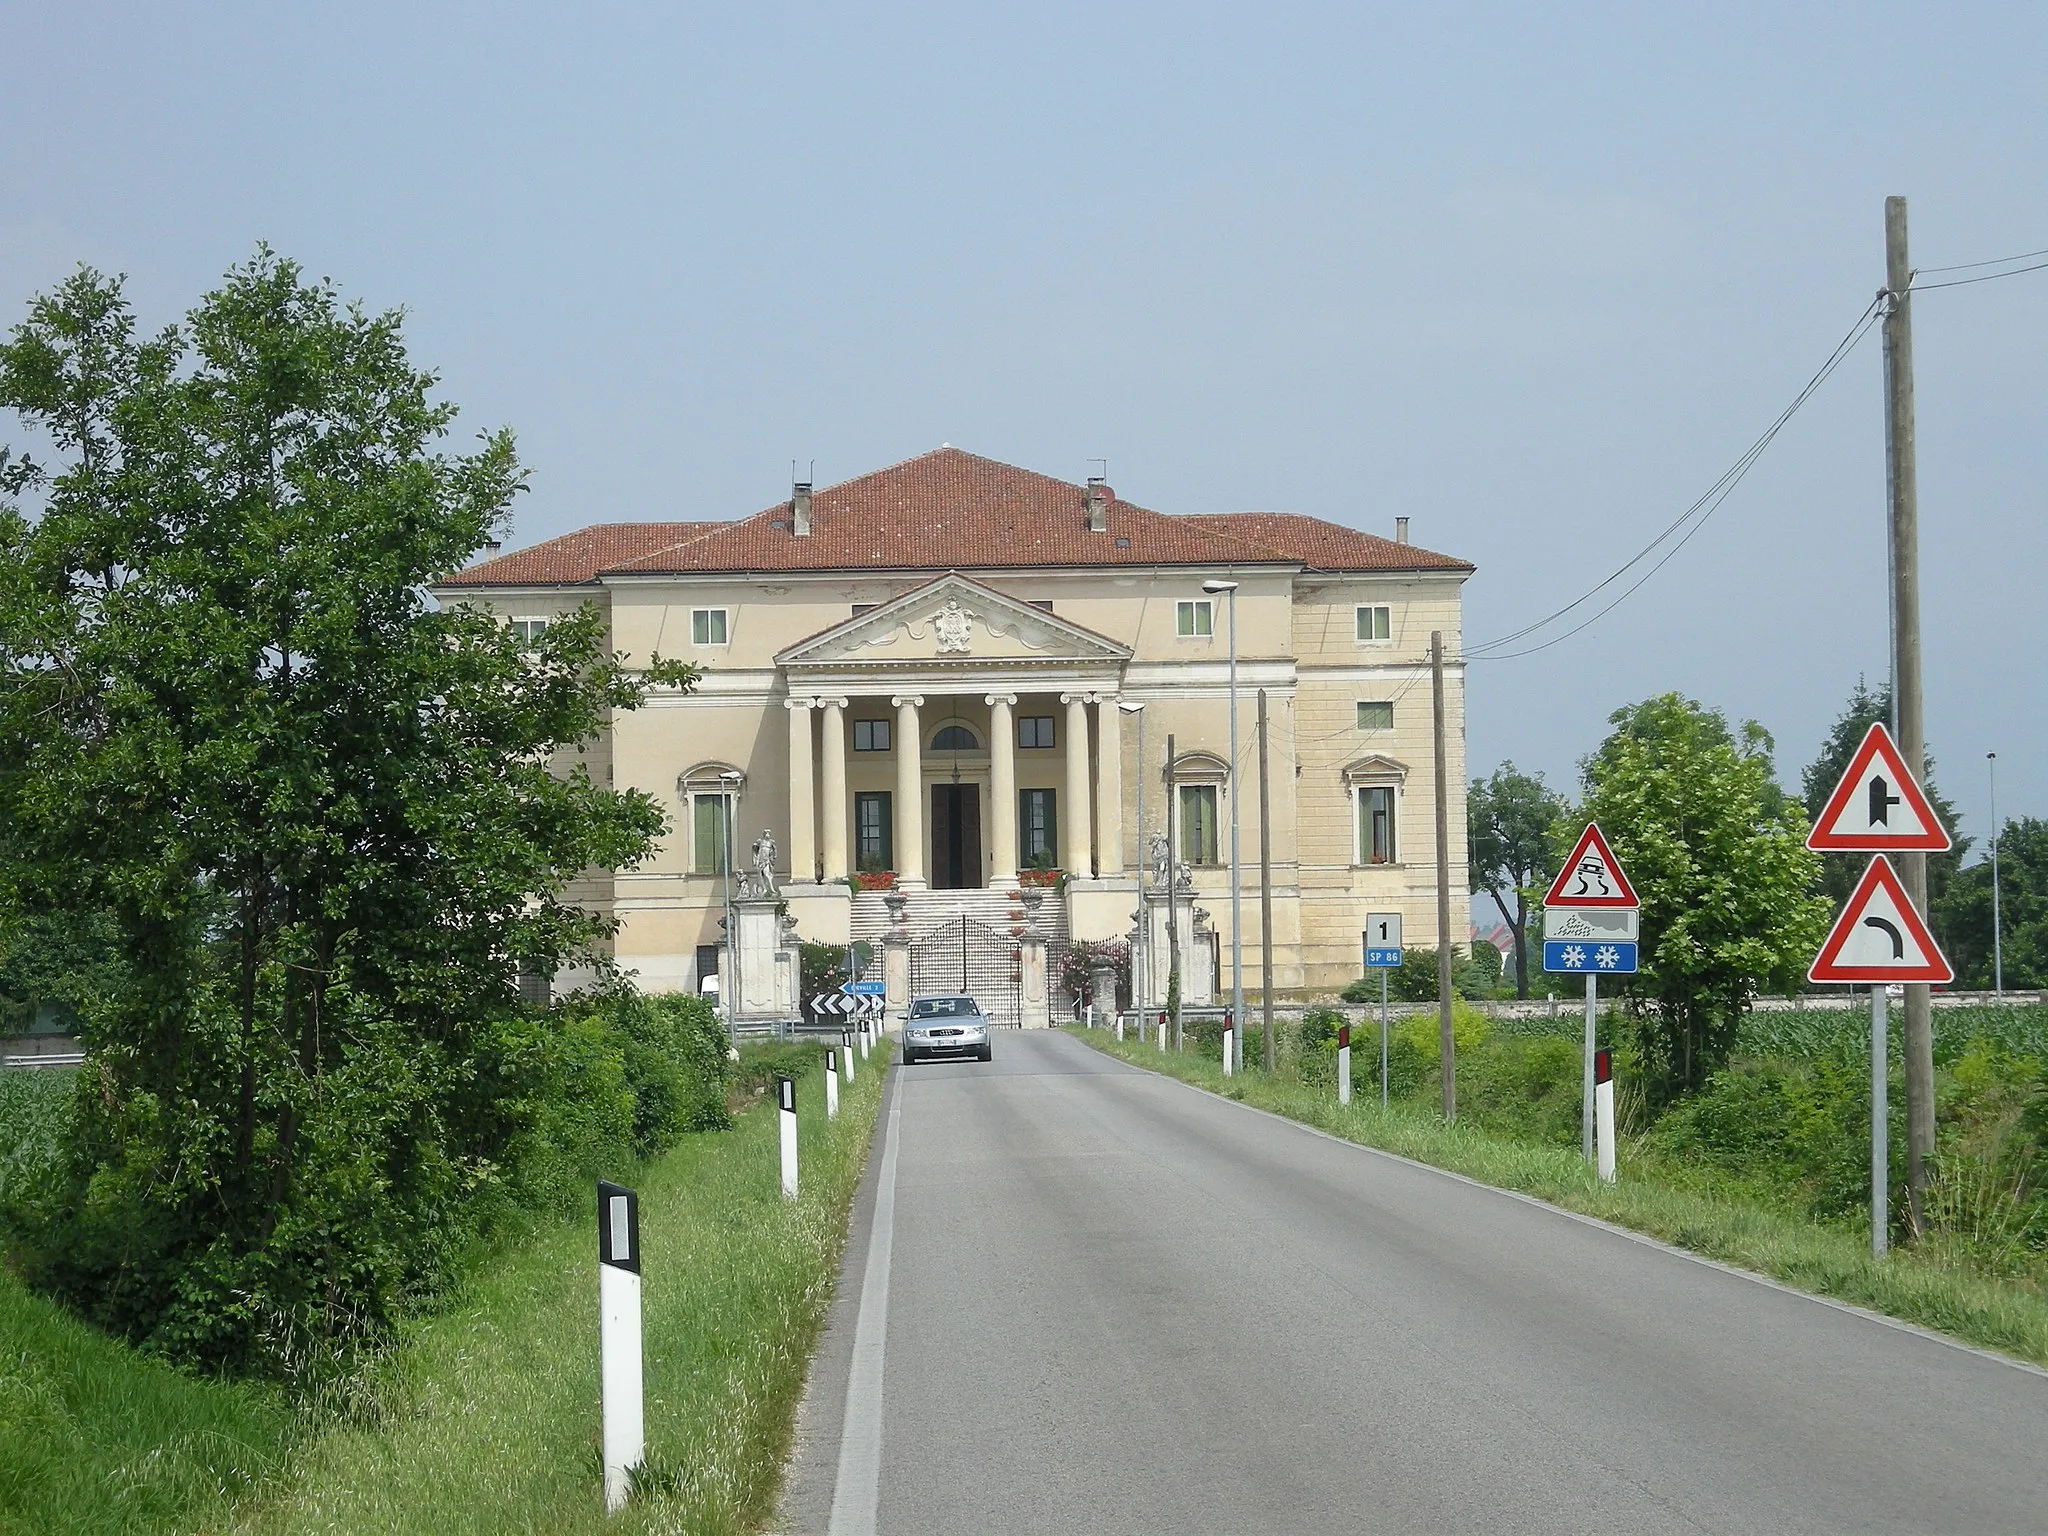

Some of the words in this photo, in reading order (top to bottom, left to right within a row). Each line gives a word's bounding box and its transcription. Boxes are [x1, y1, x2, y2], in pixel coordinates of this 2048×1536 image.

[1379, 922, 1387, 940] 1
[1370, 952, 1381, 961] SP
[1386, 952, 1398, 961] 86
